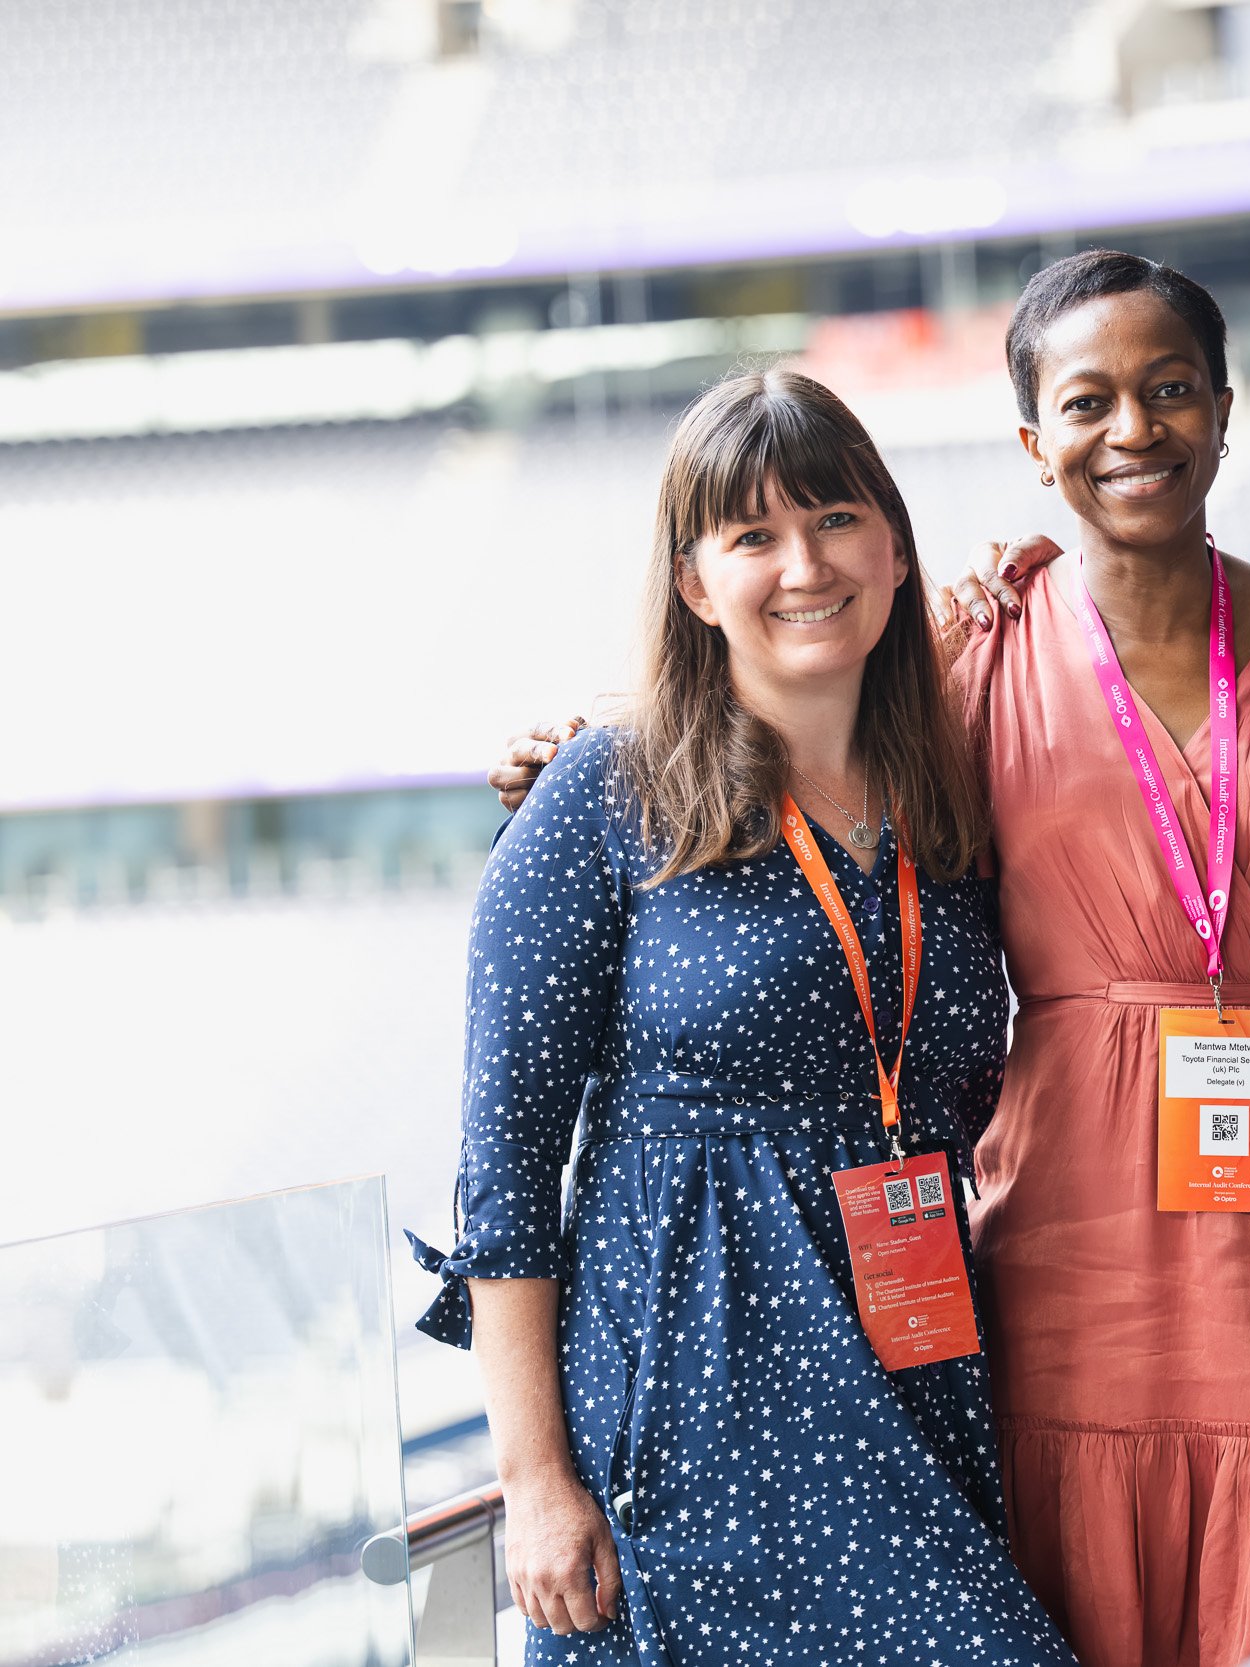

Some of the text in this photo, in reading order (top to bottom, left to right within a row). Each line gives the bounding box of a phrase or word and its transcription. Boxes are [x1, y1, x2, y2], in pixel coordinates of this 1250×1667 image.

[1218, 584, 1226, 605] Audit
[1217, 604, 1227, 657] Conference
[1111, 684, 1127, 714] Optro
[1216, 691, 1229, 719] Optro
[1135, 747, 1185, 871] Internal Audit Conference
[1215, 738, 1230, 865] Internal Audit Conference
[793, 828, 813, 861] Optro
[908, 892, 917, 948] Conference
[820, 882, 870, 1012] Internal Audit Conference
[908, 949, 917, 979] Audit
[1194, 1042, 1227, 1051] Mantwa
[1182, 1055, 1205, 1064] Toyota
[1206, 1055, 1239, 1064] Financial
[1212, 1065, 1240, 1074] (uk) Plc
[1206, 1078, 1235, 1086] Delegate
[890, 1235, 921, 1245] Stadium_Guest
[889, 1246, 906, 1254] network
[884, 1286, 905, 1294] Chartered
[905, 1283, 921, 1291] Institute
[943, 1275, 960, 1283] Auditors
[891, 1292, 905, 1300] Ireland
[878, 1302, 899, 1310] Chartered
[891, 1334, 910, 1343] Internal
[911, 1330, 924, 1338] Audit
[923, 1326, 951, 1335] Conference
[919, 1344, 933, 1352] Optro
